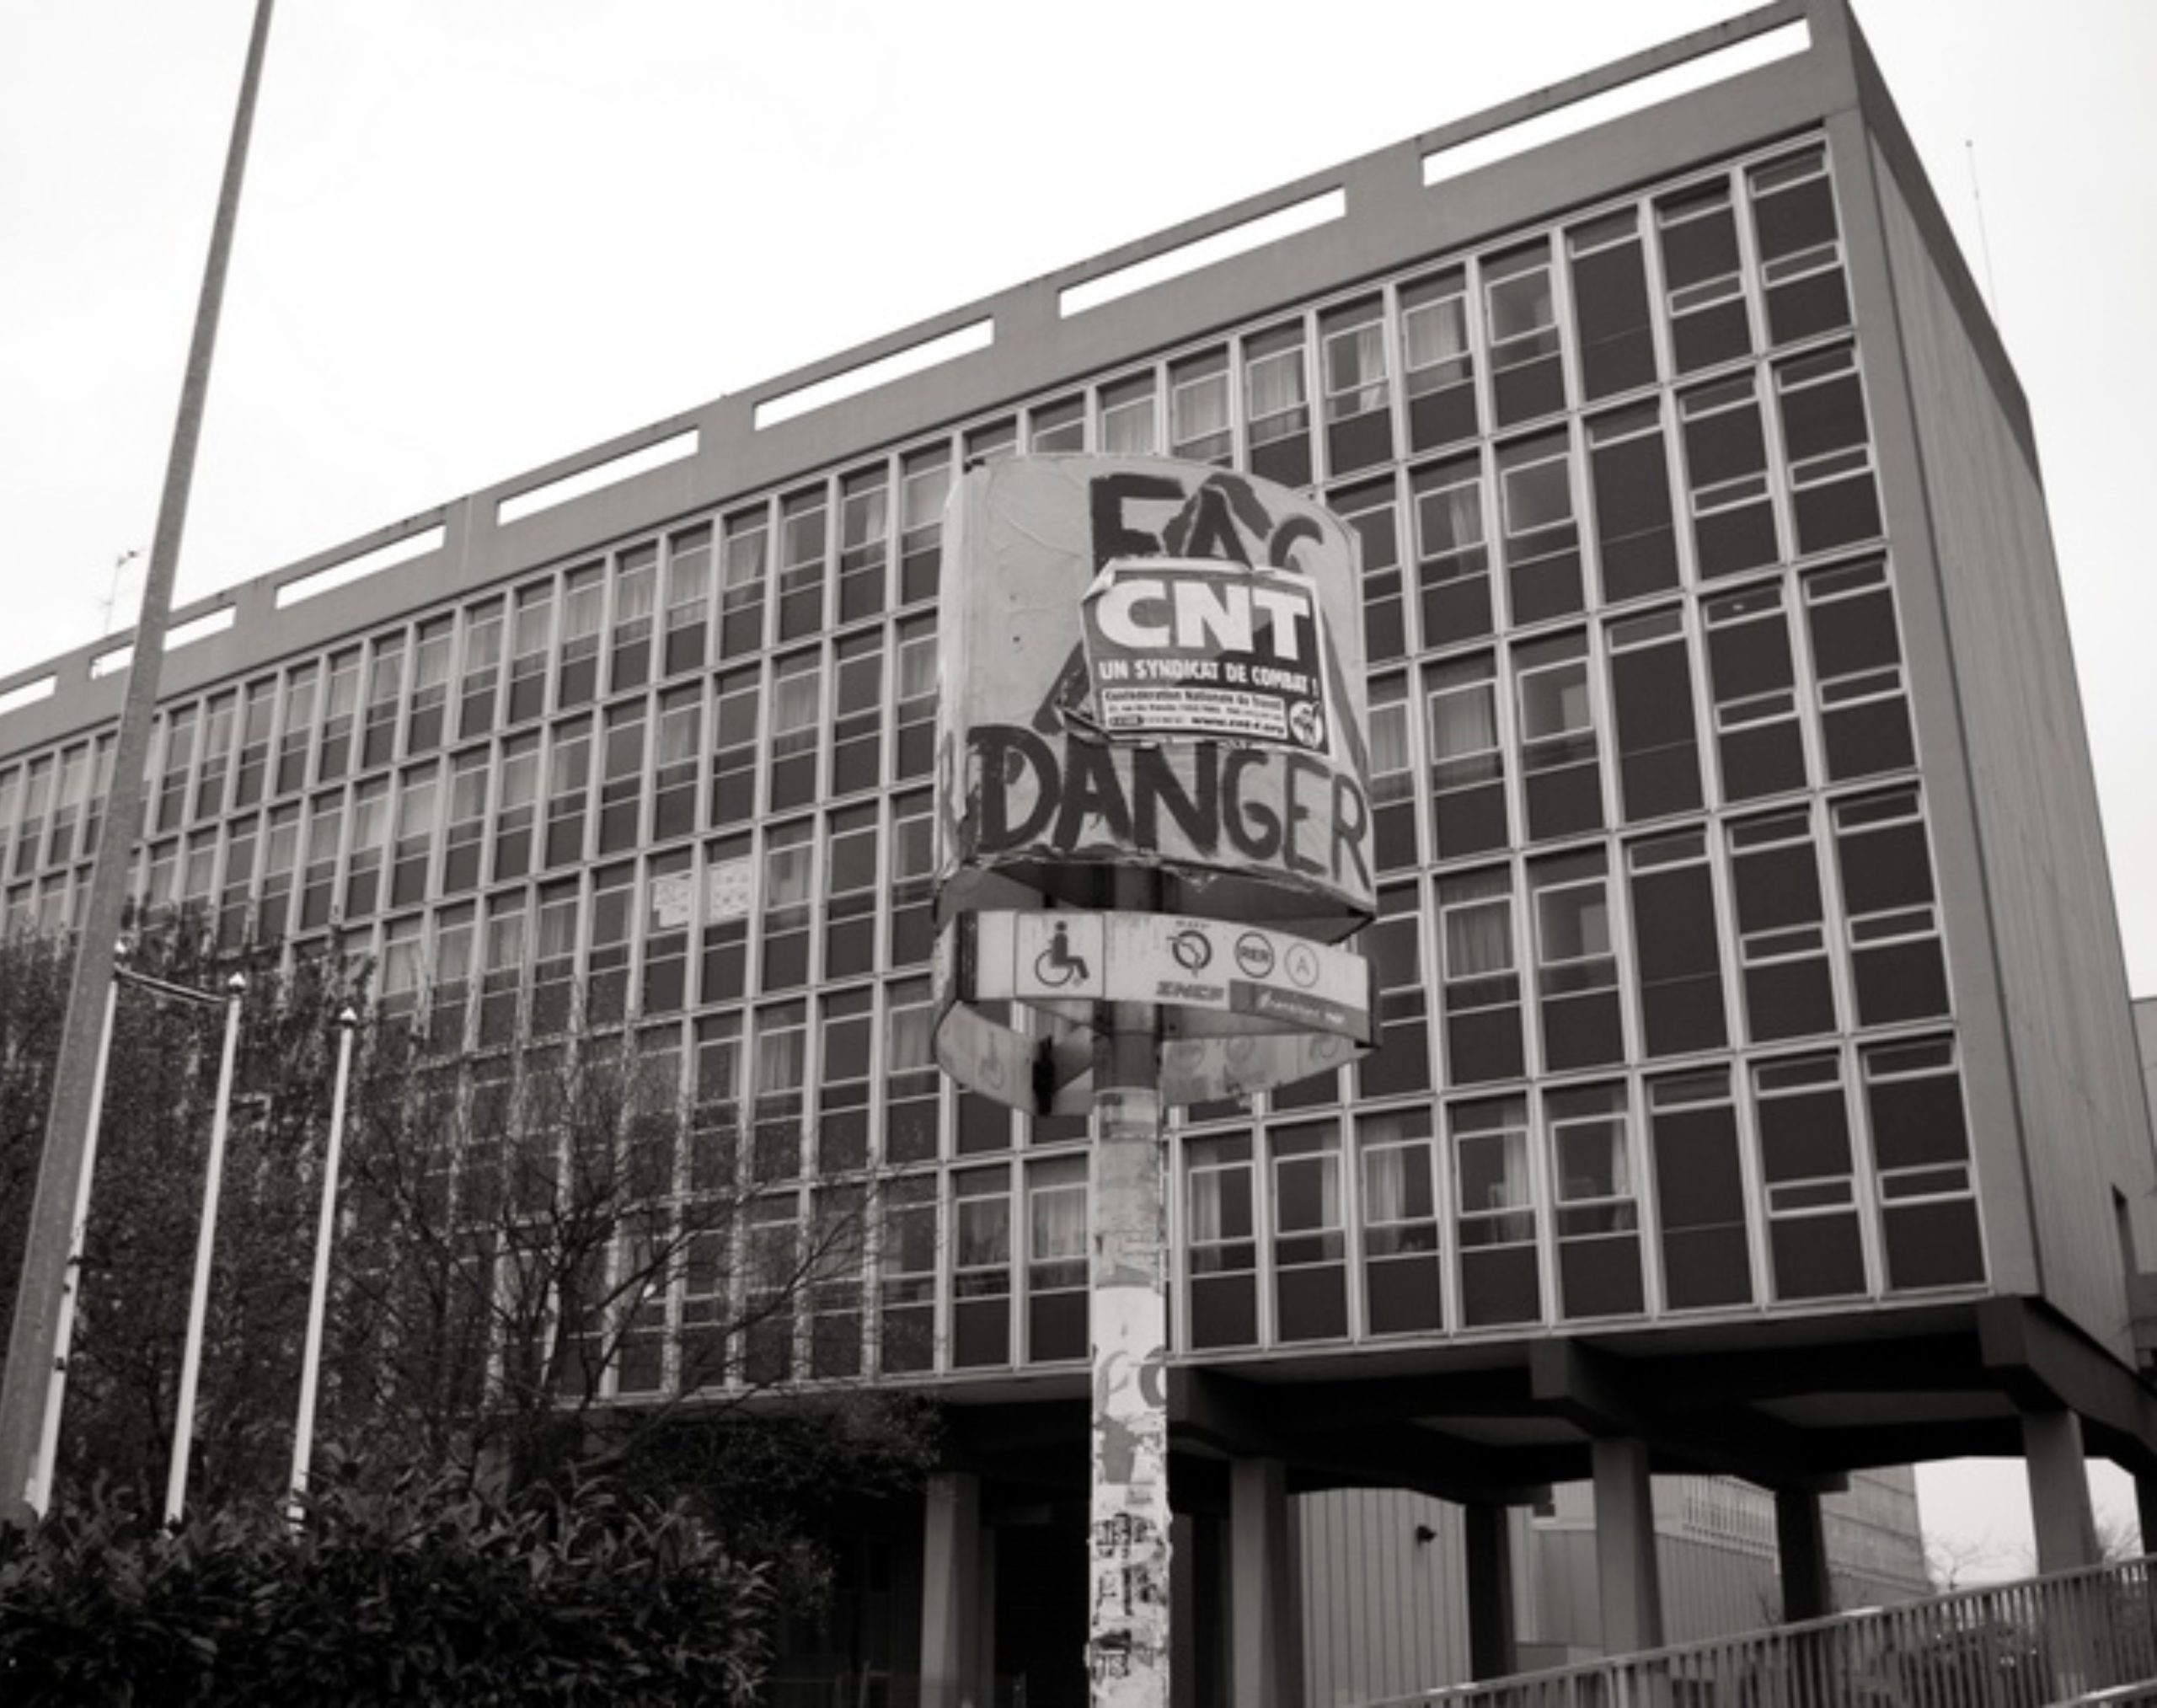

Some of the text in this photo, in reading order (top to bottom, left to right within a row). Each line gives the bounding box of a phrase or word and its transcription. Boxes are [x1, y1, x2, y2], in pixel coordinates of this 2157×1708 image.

[1096, 579, 1310, 661] CNT
[1099, 660, 1128, 681] UN
[1133, 659, 1218, 681] SYNDICAT
[1225, 661, 1246, 683] DE
[1251, 666, 1308, 693] COMBAT
[966, 722, 1374, 895] DANGER
[1296, 955, 1311, 977] A
